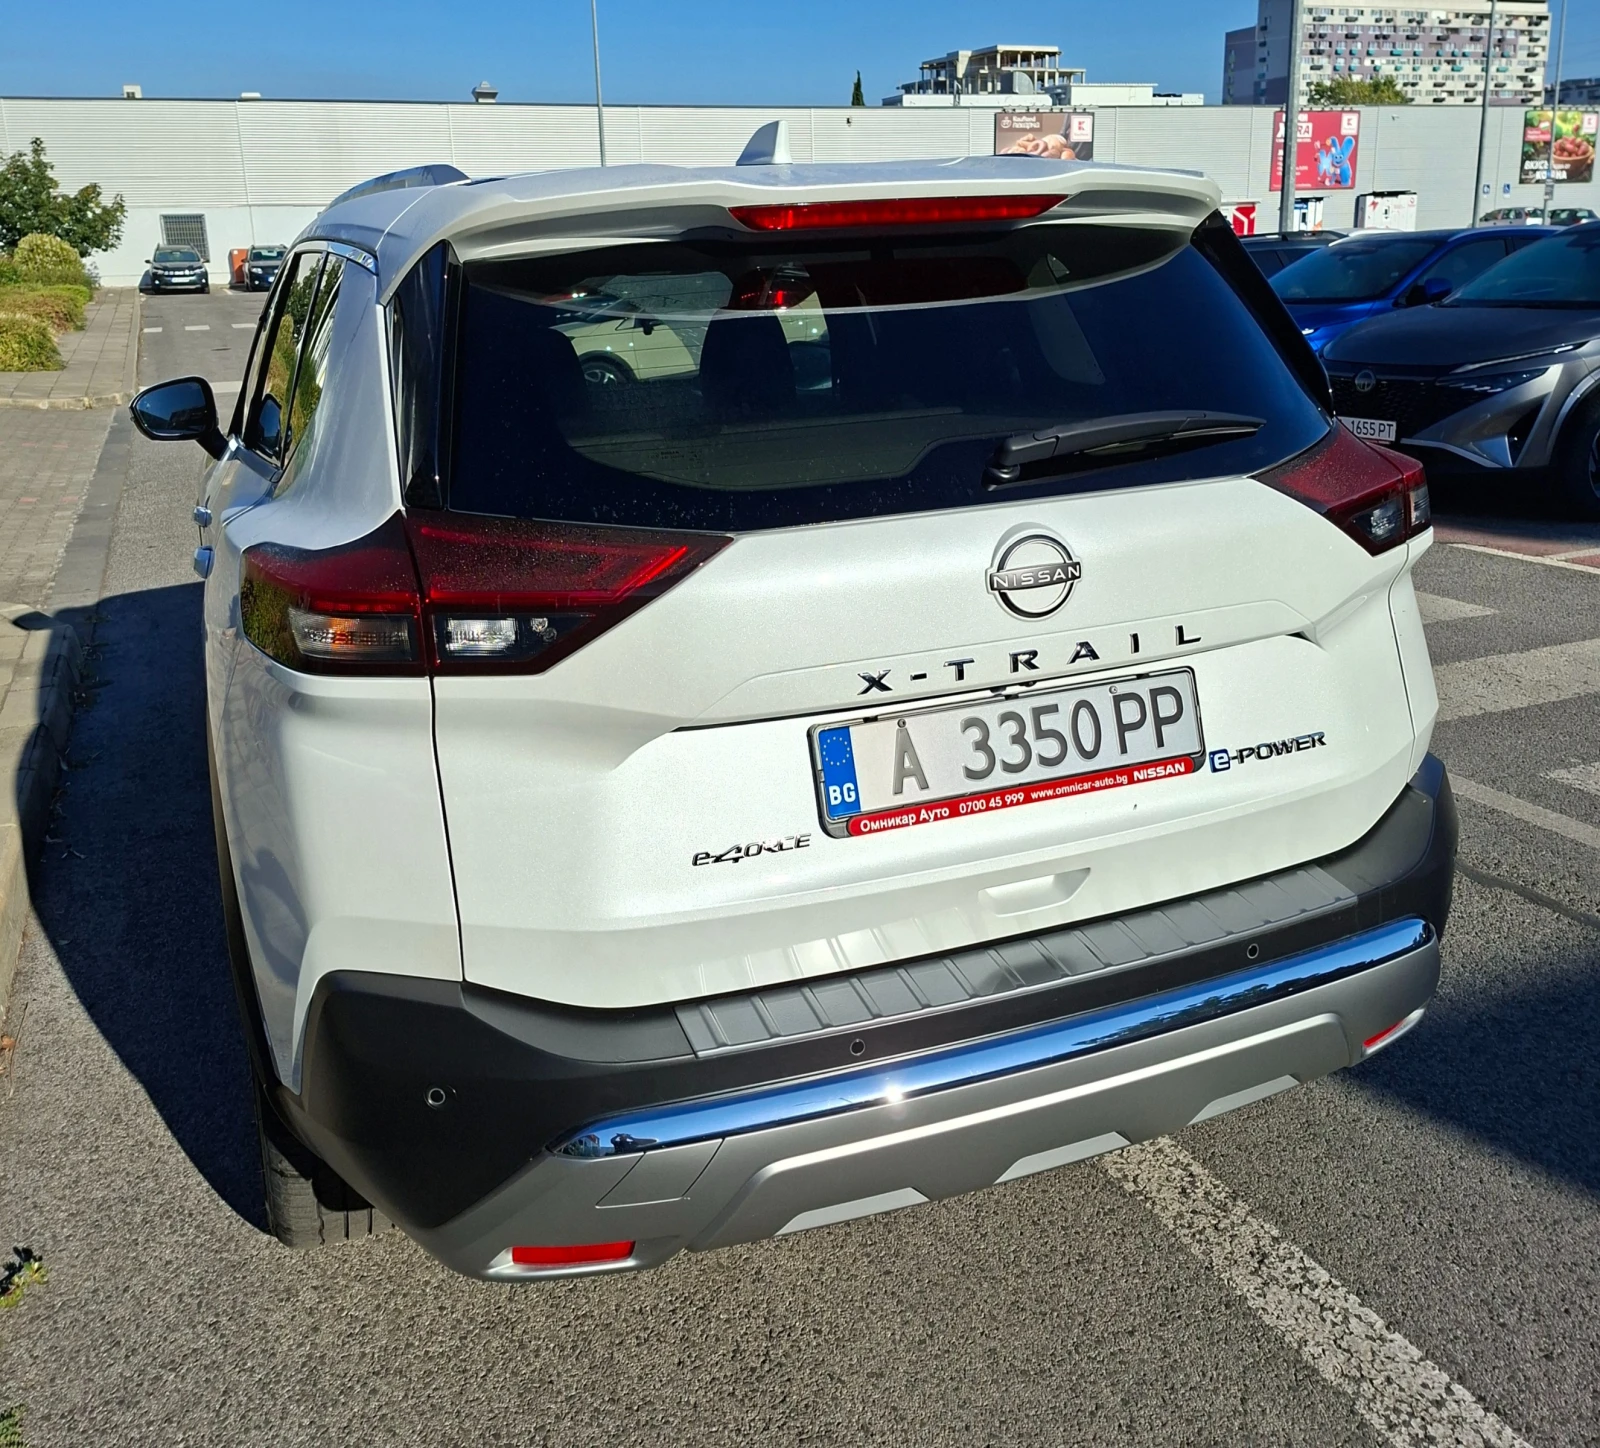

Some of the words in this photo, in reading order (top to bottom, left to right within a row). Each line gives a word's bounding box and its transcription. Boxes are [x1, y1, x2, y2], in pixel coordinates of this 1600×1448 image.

[1351, 420, 1376, 436] 1655
[1377, 423, 1394, 439] PT
[993, 564, 1081, 589] NISSAN
[857, 625, 1202, 696] X-TRAIL
[892, 726, 929, 796] A
[960, 699, 1102, 781] 3350
[1113, 685, 1184, 755] PP
[1209, 731, 1327, 773] e-POWER
[828, 783, 856, 807] BG
[860, 812, 916, 832] Омникар
[919, 806, 949, 822] Ауто
[959, 799, 986, 814] 0700
[989, 797, 1002, 808] 45
[1005, 792, 1024, 805] 999
[1030, 774, 1128, 799] www.omnicar-auto.bg
[1133, 762, 1185, 781] NISSAN
